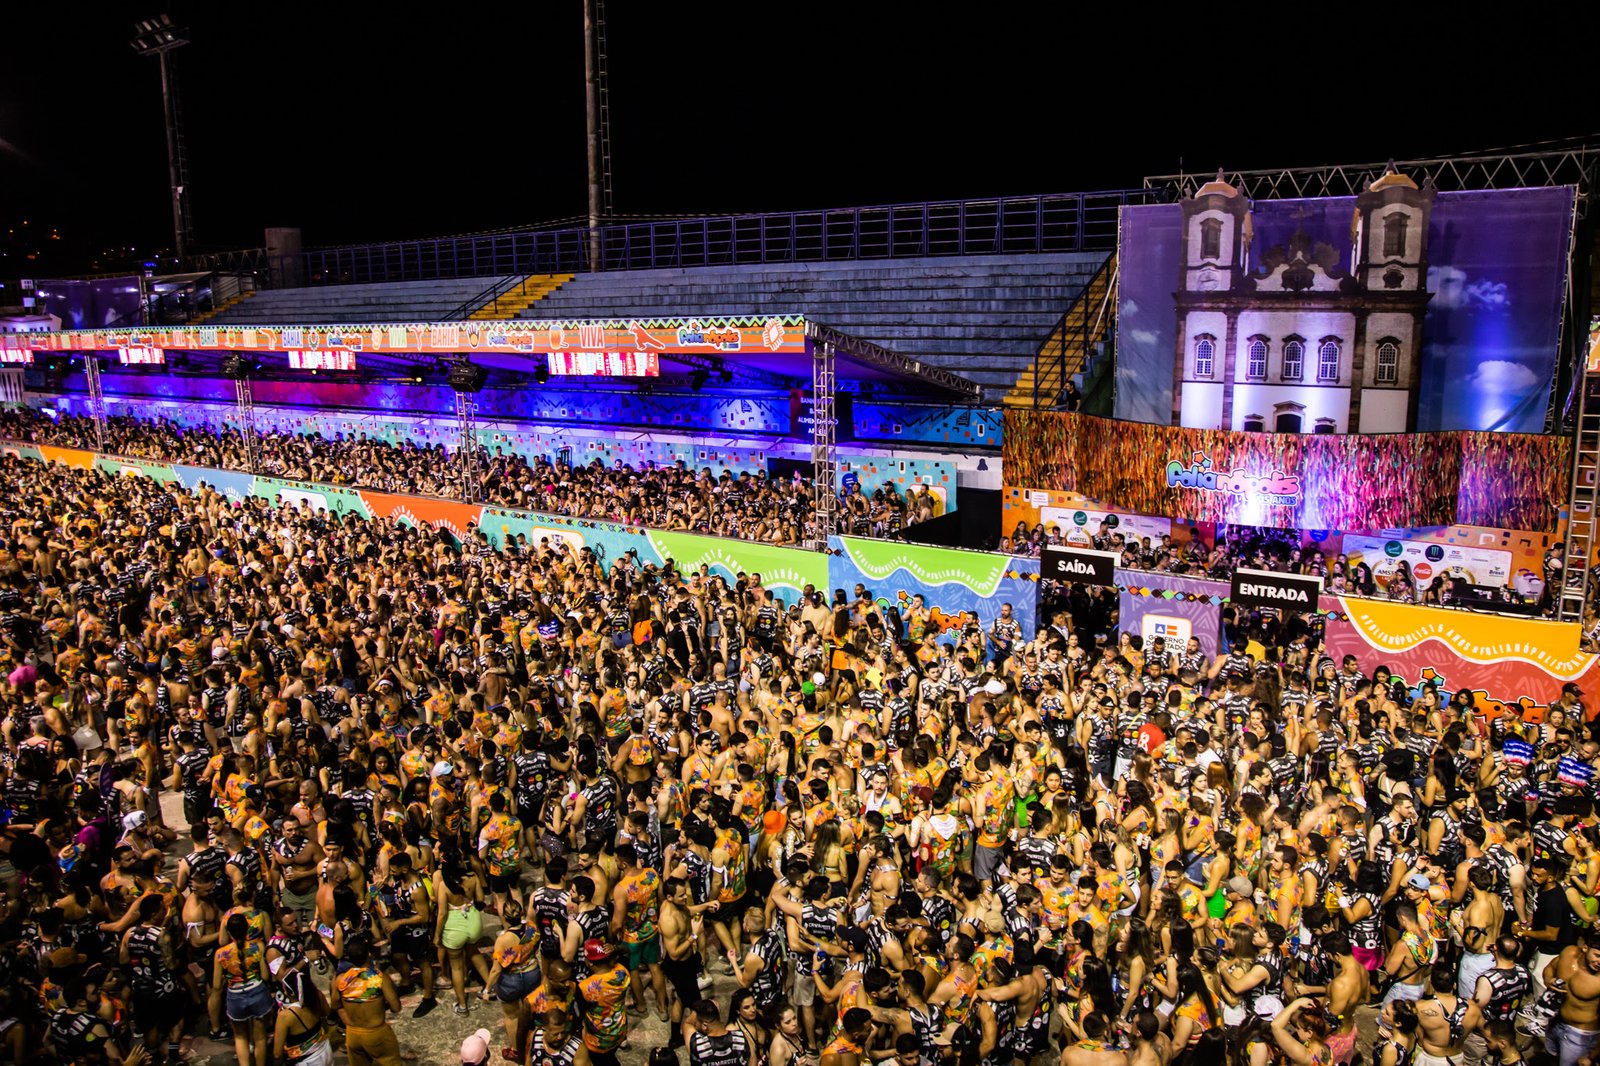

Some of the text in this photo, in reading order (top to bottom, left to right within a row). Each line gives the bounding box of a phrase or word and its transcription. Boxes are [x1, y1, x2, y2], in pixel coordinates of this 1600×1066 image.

[431, 326, 459, 347] BAHIA!
[580, 325, 604, 347] VIVA
[1271, 495, 1297, 506] ANOS
[1057, 559, 1096, 576] SAÍDA
[1239, 583, 1309, 602] ENTRADA
[1446, 629, 1471, 653] ANOS
